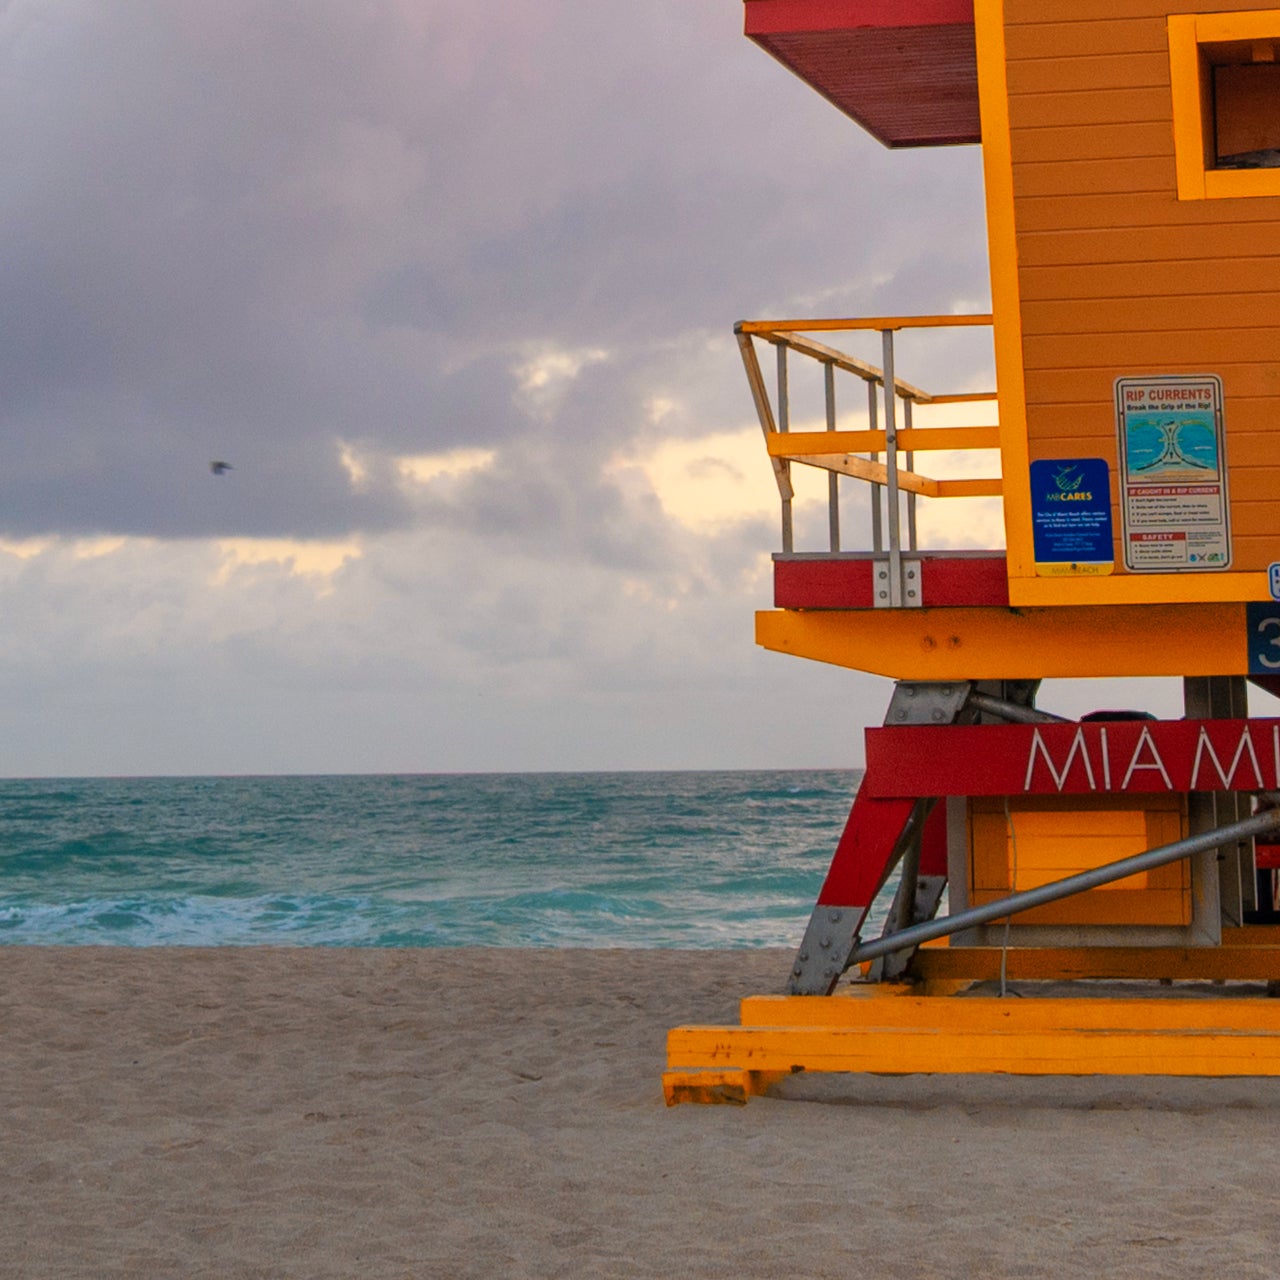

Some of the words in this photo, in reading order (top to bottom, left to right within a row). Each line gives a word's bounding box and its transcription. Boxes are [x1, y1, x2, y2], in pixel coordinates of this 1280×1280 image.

[1126, 390, 1145, 401] RIP
[1148, 388, 1212, 401] CURRENTS
[1161, 403, 1175, 411] Grip
